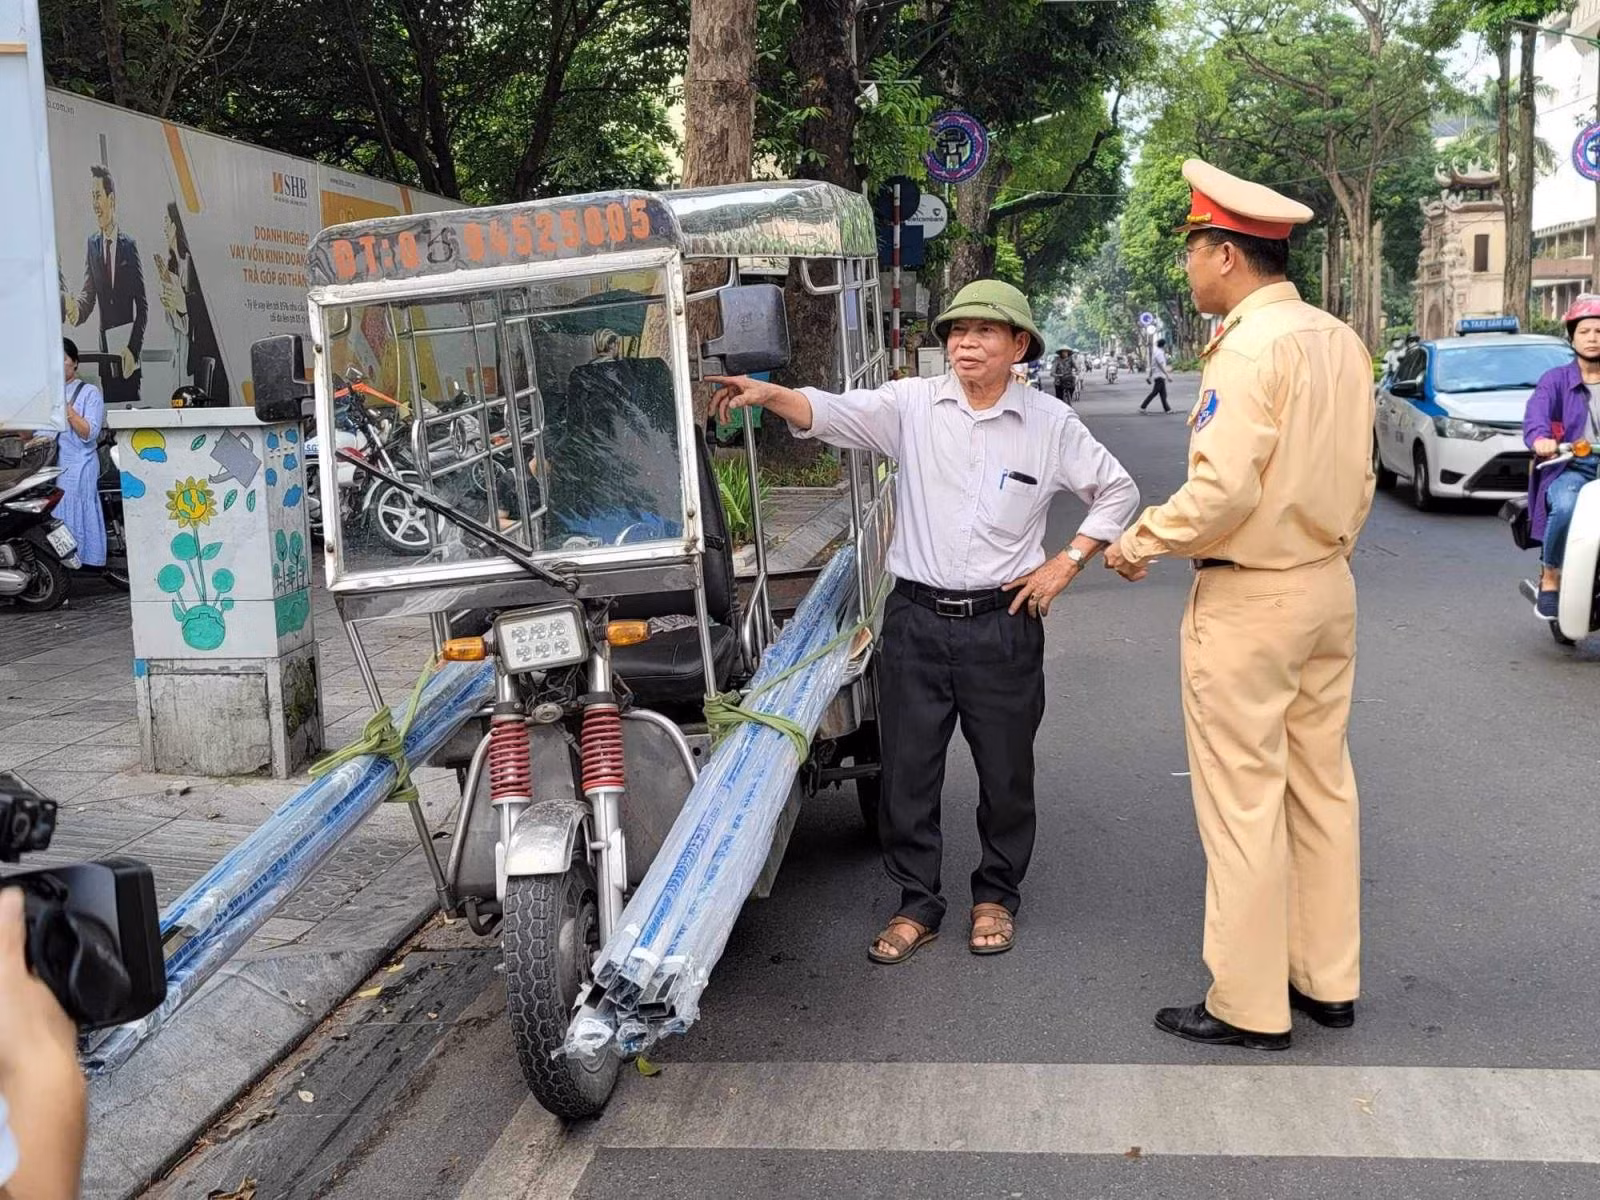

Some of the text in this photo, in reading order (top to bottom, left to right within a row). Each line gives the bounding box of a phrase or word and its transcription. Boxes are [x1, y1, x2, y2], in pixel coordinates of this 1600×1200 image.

[284, 174, 307, 199] SHB
[254, 226, 282, 242] DOANH
[229, 243, 247, 260] VAY
[265, 249, 284, 264] KINH
[285, 251, 309, 267] DOAN
[260, 267, 276, 285] GÓP
[278, 272, 287, 286] 60
[287, 270, 308, 288] THÁN
